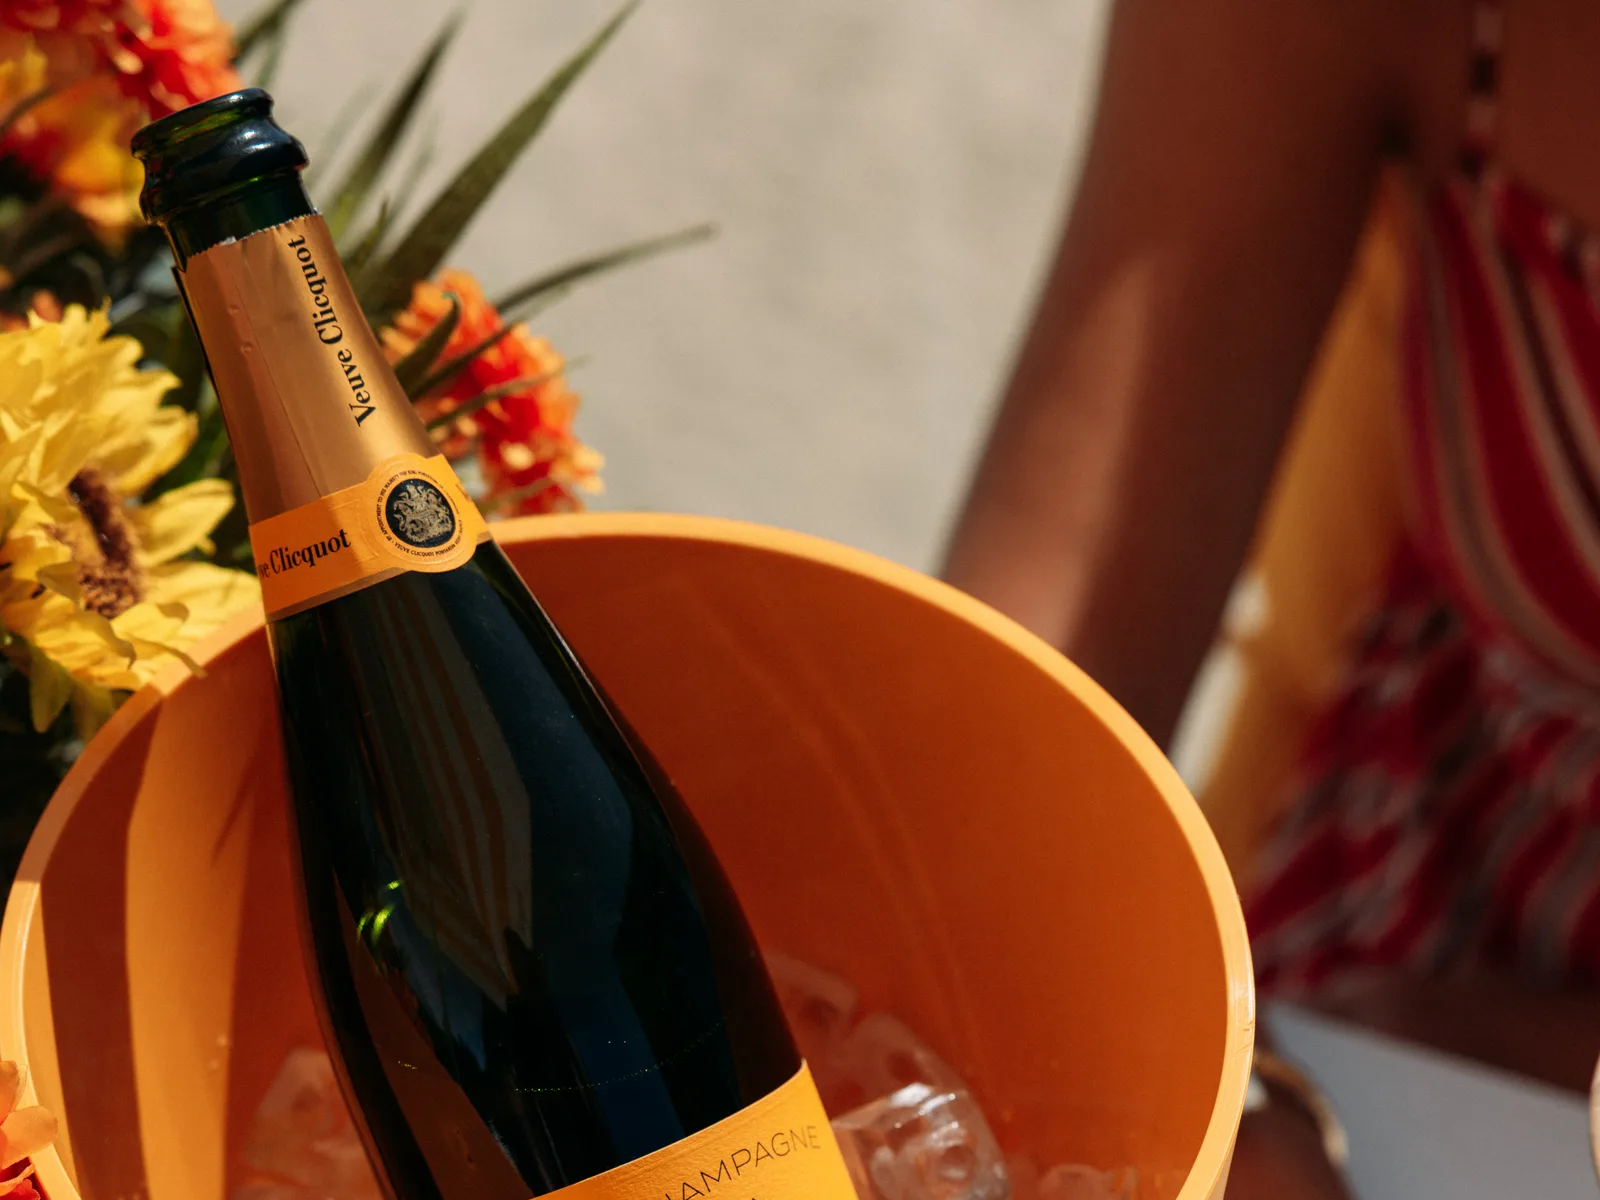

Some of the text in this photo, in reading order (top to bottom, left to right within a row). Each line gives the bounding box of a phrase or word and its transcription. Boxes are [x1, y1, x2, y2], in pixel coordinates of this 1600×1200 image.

[288, 235, 376, 427] Veuve Clicquot
[270, 528, 351, 574] Clicquot
